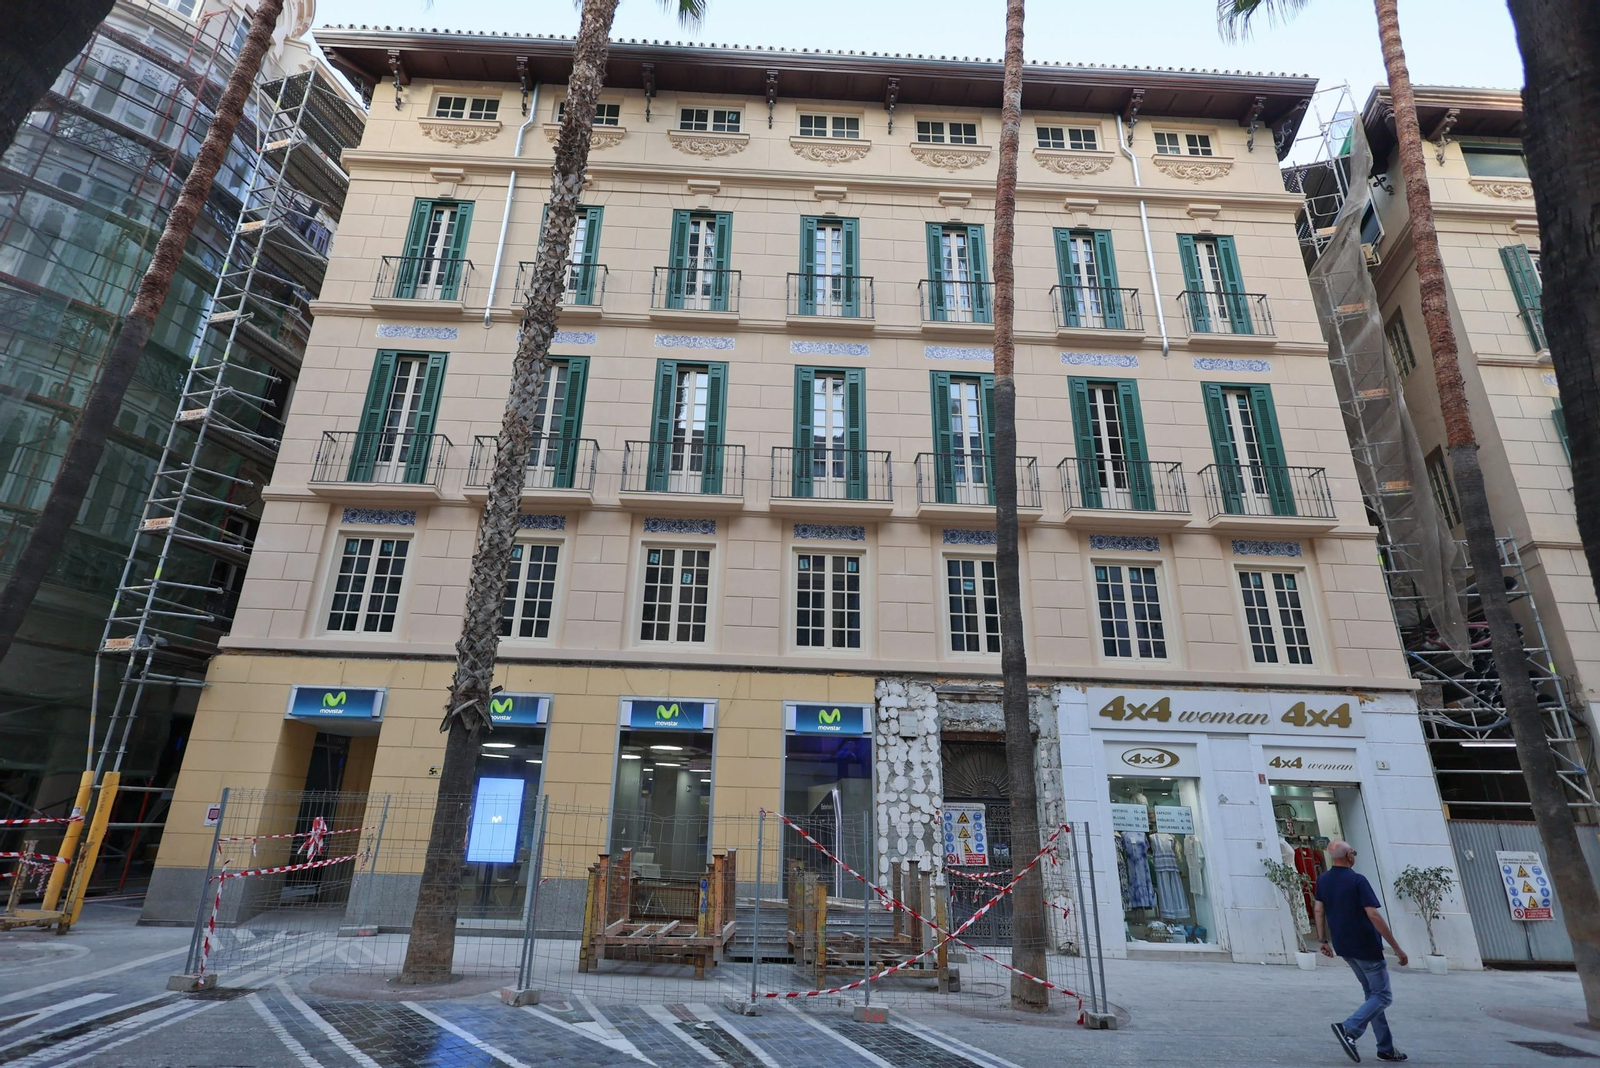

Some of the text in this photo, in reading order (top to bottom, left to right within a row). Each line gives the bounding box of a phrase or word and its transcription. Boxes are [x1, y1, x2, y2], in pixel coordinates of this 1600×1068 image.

[1099, 695, 1352, 728] 4x4 woman 4x4
[1127, 753, 1166, 765] 4x4
[1269, 756, 1354, 771] 4x4 woman
